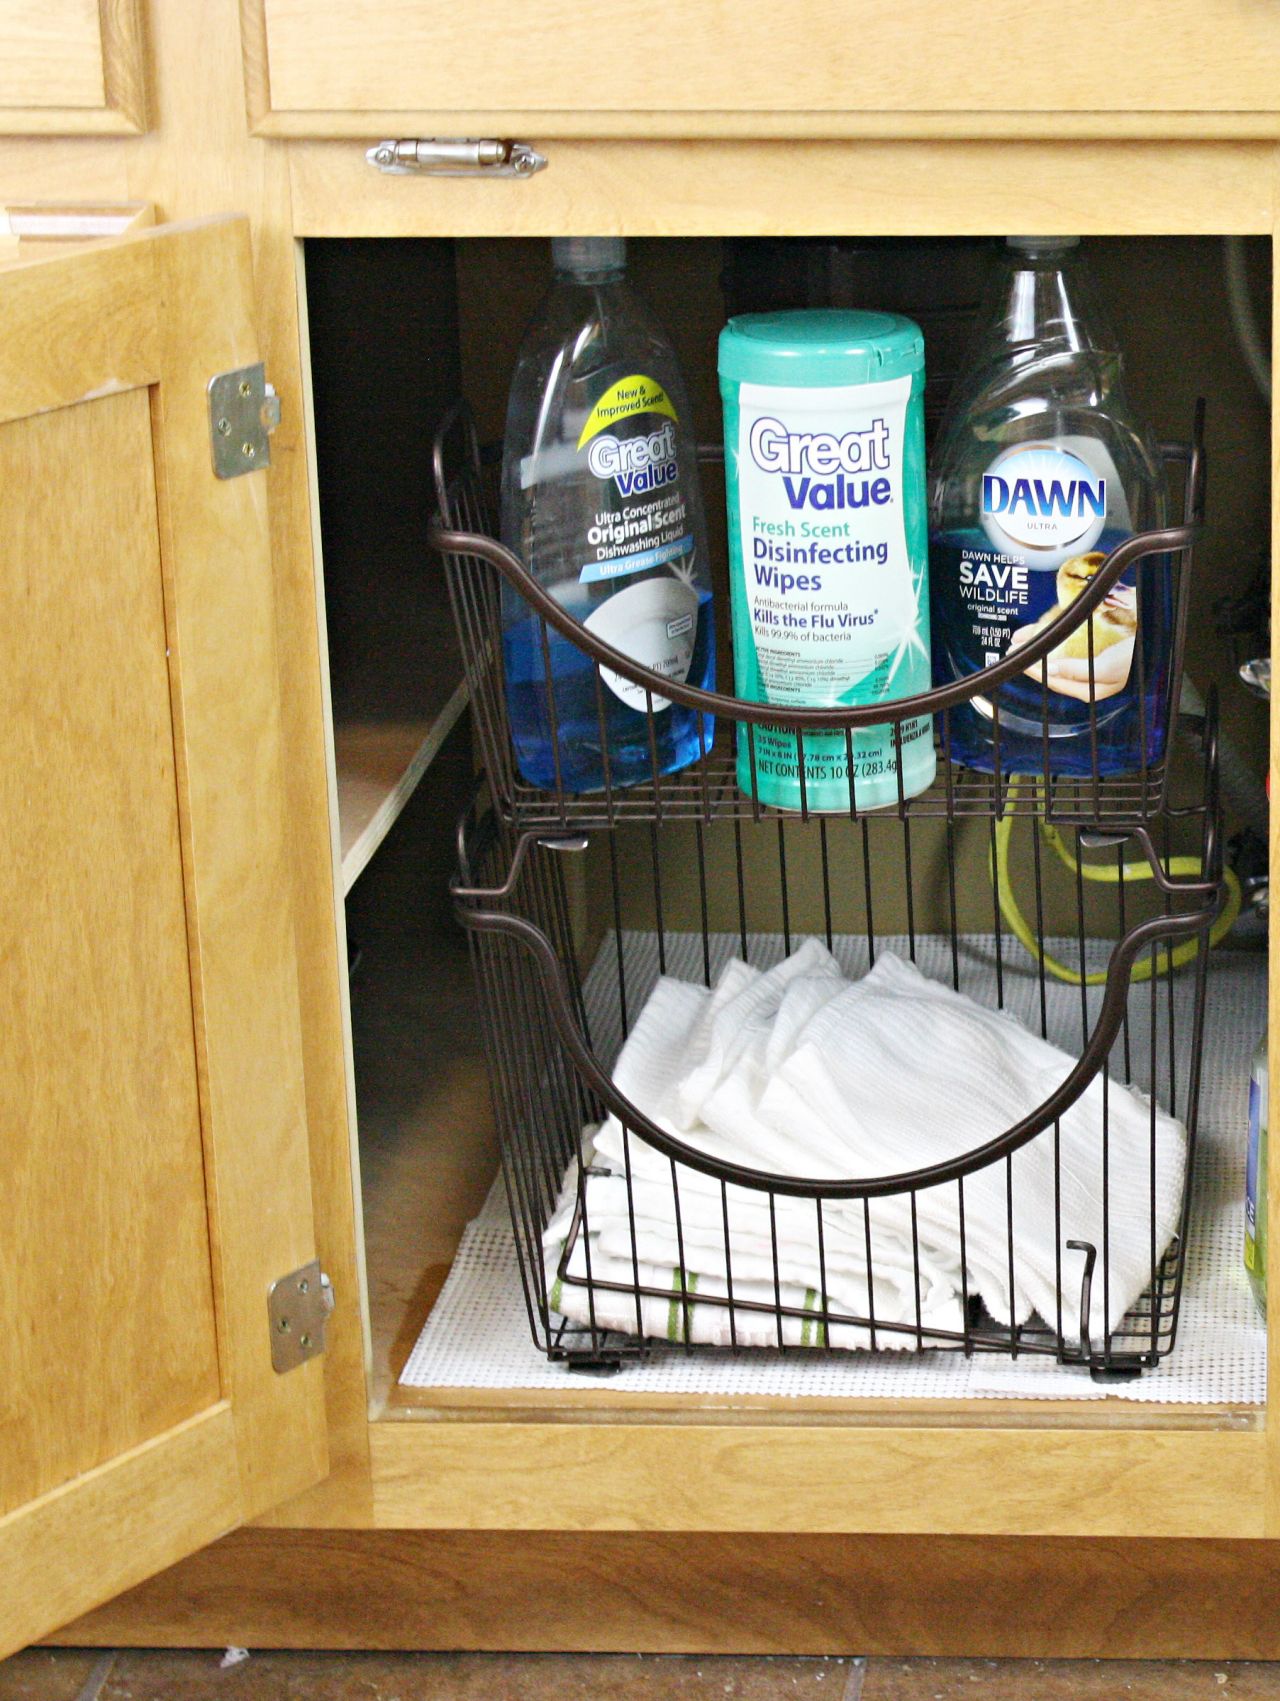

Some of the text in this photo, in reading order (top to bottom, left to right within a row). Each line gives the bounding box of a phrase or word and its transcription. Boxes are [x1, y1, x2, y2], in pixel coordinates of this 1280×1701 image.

[617, 388, 638, 401] New
[597, 397, 641, 418] Improved
[588, 421, 677, 479] Great
[750, 416, 890, 475] Great
[615, 461, 678, 498] Value
[782, 474, 891, 510] Value
[982, 473, 1107, 518] DAWN
[595, 491, 680, 526] Ultra Concentrated
[587, 504, 686, 545] Original Scent
[753, 516, 851, 538] Fresh Scent
[1026, 522, 1058, 531] ULTRA
[596, 523, 684, 560] Dishwashing Liquid
[753, 537, 888, 565] Disinfecting
[962, 550, 1026, 565] DAWN HELPS
[600, 564, 623, 575] Ultra
[754, 563, 822, 595] Wipes
[960, 561, 1028, 590] SAVE
[754, 595, 849, 612] Antibacterial formula
[960, 585, 1028, 605] WILDLIFE
[754, 608, 779, 625] Kills
[783, 612, 807, 628] the
[811, 615, 834, 629] Flu
[967, 603, 1019, 616] original scent
[754, 623, 852, 642] Kills 99.9% of bacteria
[759, 760, 774, 775] NET
[775, 763, 827, 780] CONTNTS
[830, 765, 843, 779] 10
[862, 759, 898, 778] (283.4g
